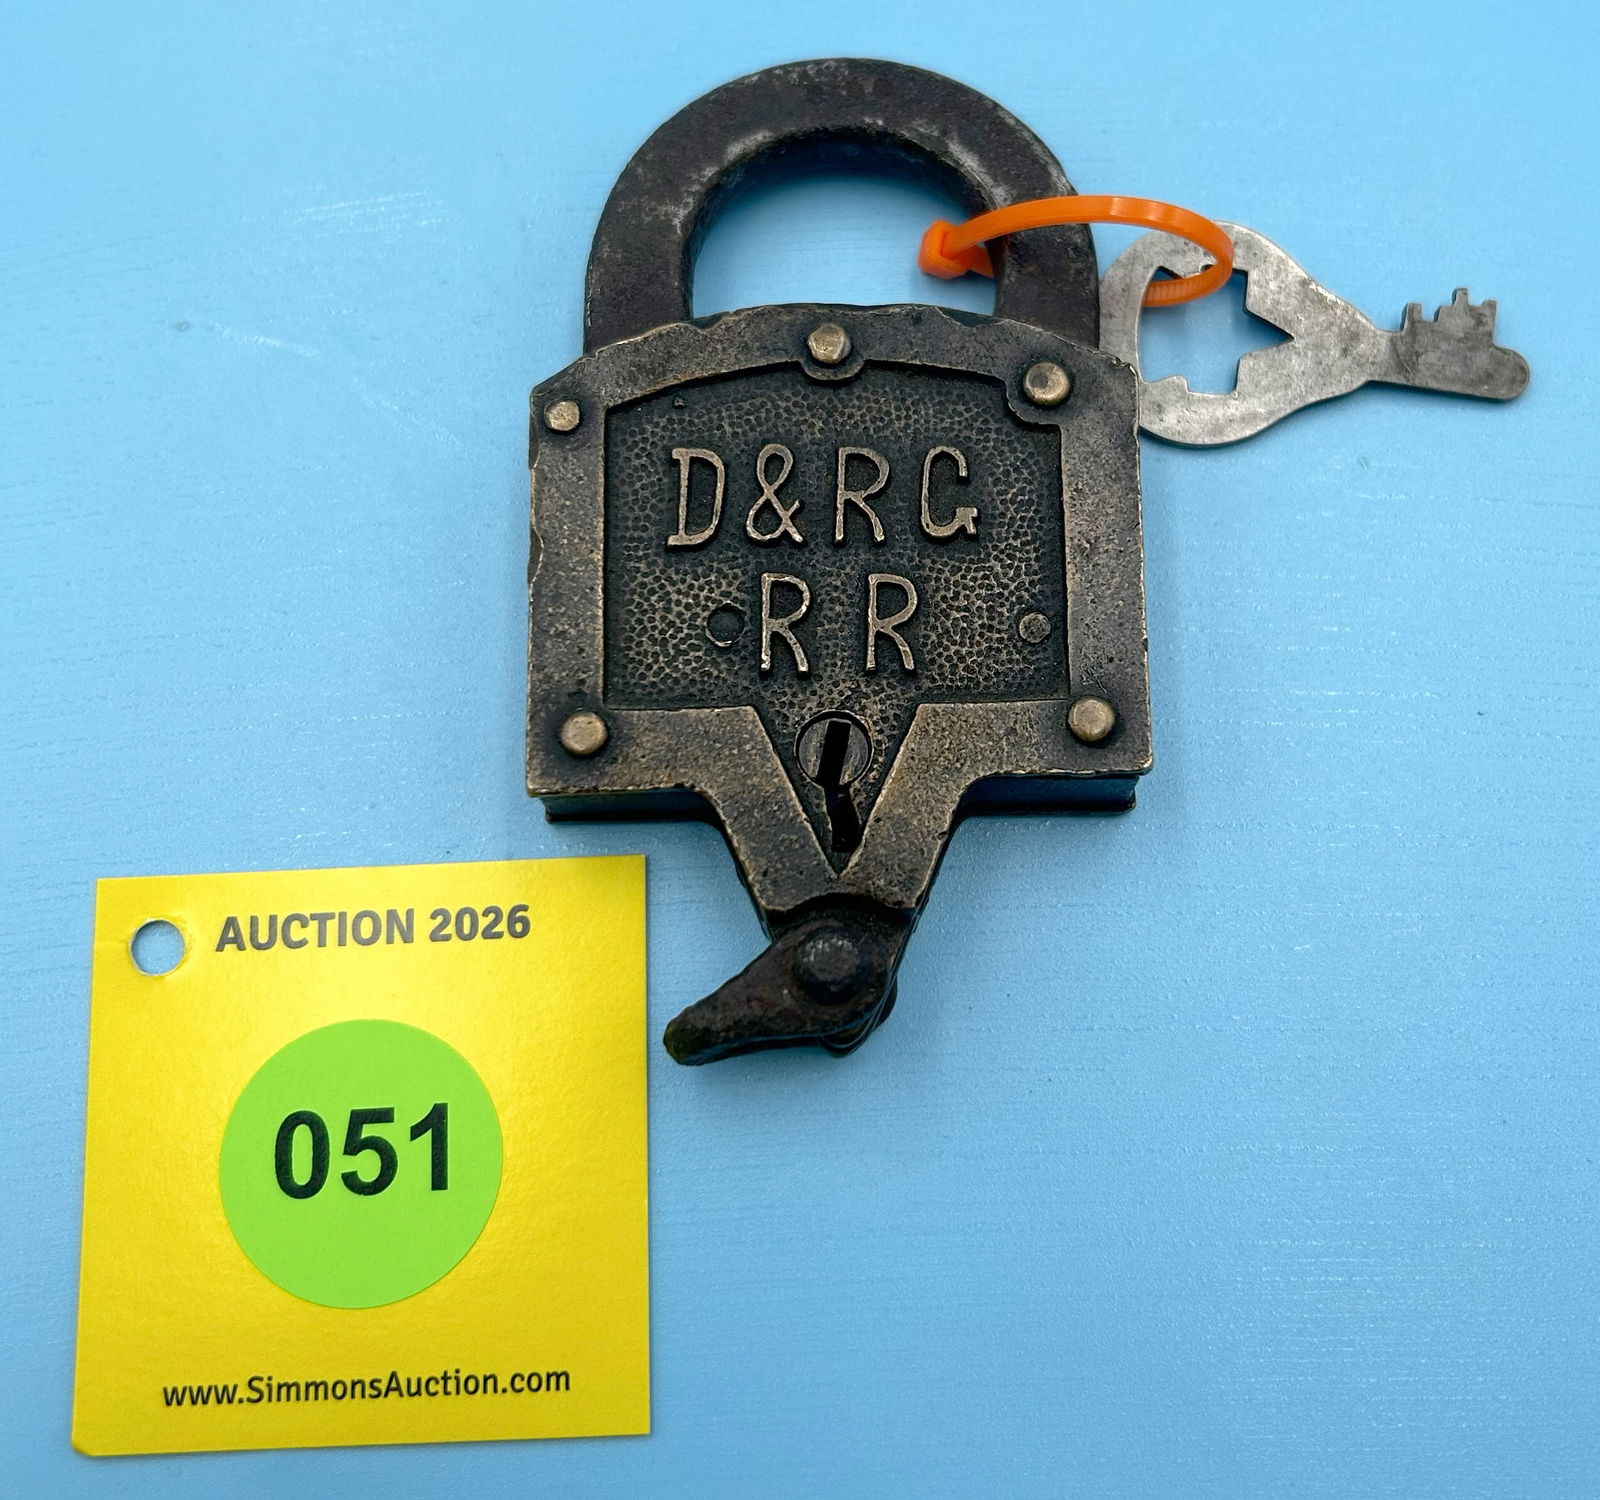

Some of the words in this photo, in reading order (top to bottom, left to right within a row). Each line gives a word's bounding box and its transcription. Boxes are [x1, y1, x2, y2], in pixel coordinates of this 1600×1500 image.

[215, 908, 415, 953] AUCTION
[428, 903, 531, 943] 2026
[275, 1102, 448, 1200] 051
[163, 1368, 571, 1408] www.SimmonsAuction.com
